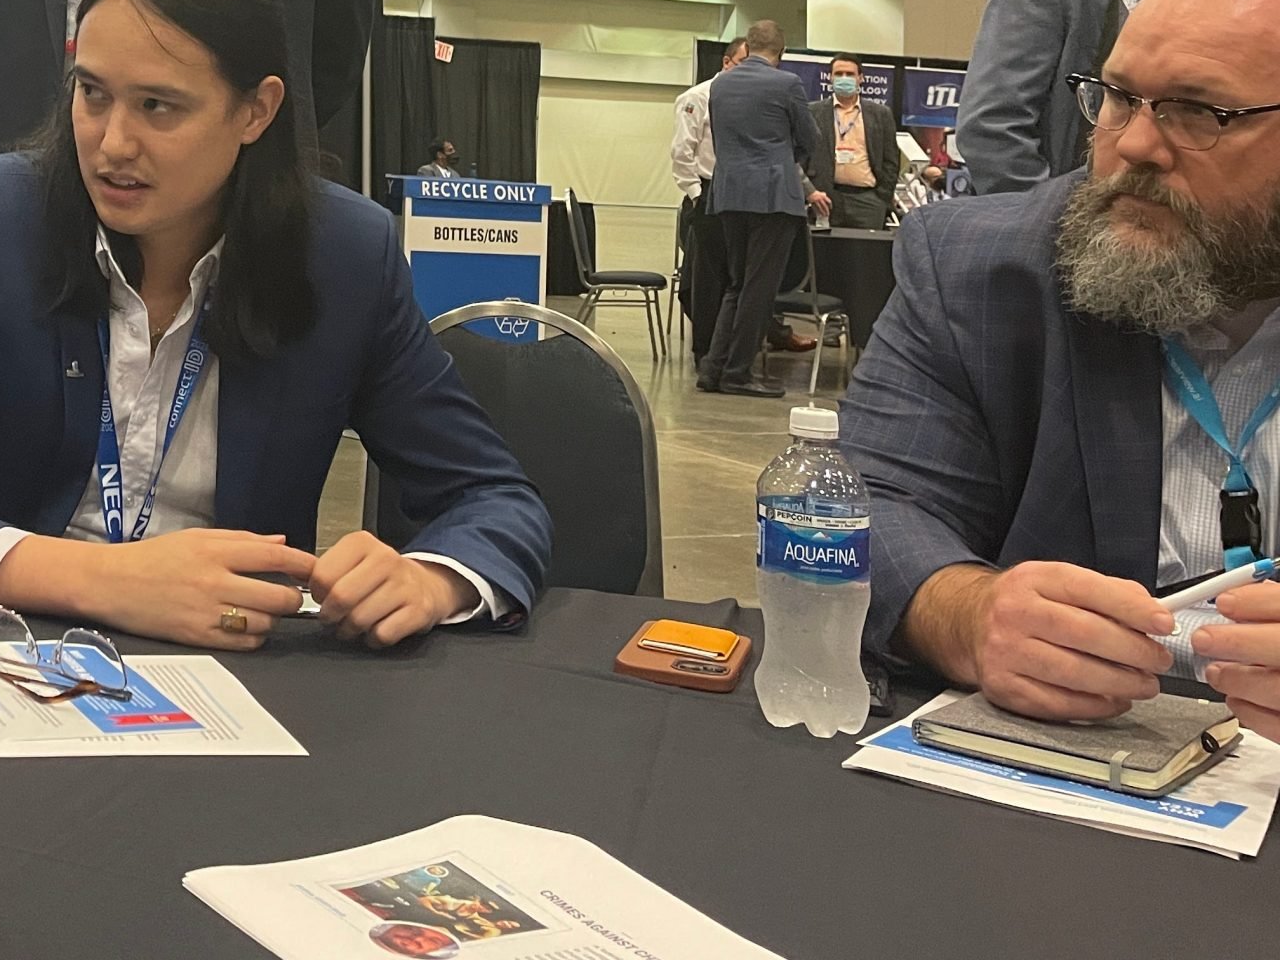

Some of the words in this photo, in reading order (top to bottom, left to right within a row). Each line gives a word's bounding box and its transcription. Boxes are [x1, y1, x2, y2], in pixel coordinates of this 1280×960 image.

[820, 71, 888, 85] INATION
[820, 82, 888, 95] TEOLOGY
[422, 181, 488, 200] RECYCLE
[494, 185, 536, 202] ONLY
[434, 226, 519, 244] BOTTLES/CANS
[101, 464, 122, 535] NEC
[784, 541, 857, 567] AQUAFINA
[540, 889, 586, 920] CRIMES
[580, 919, 639, 950] AGAINST
